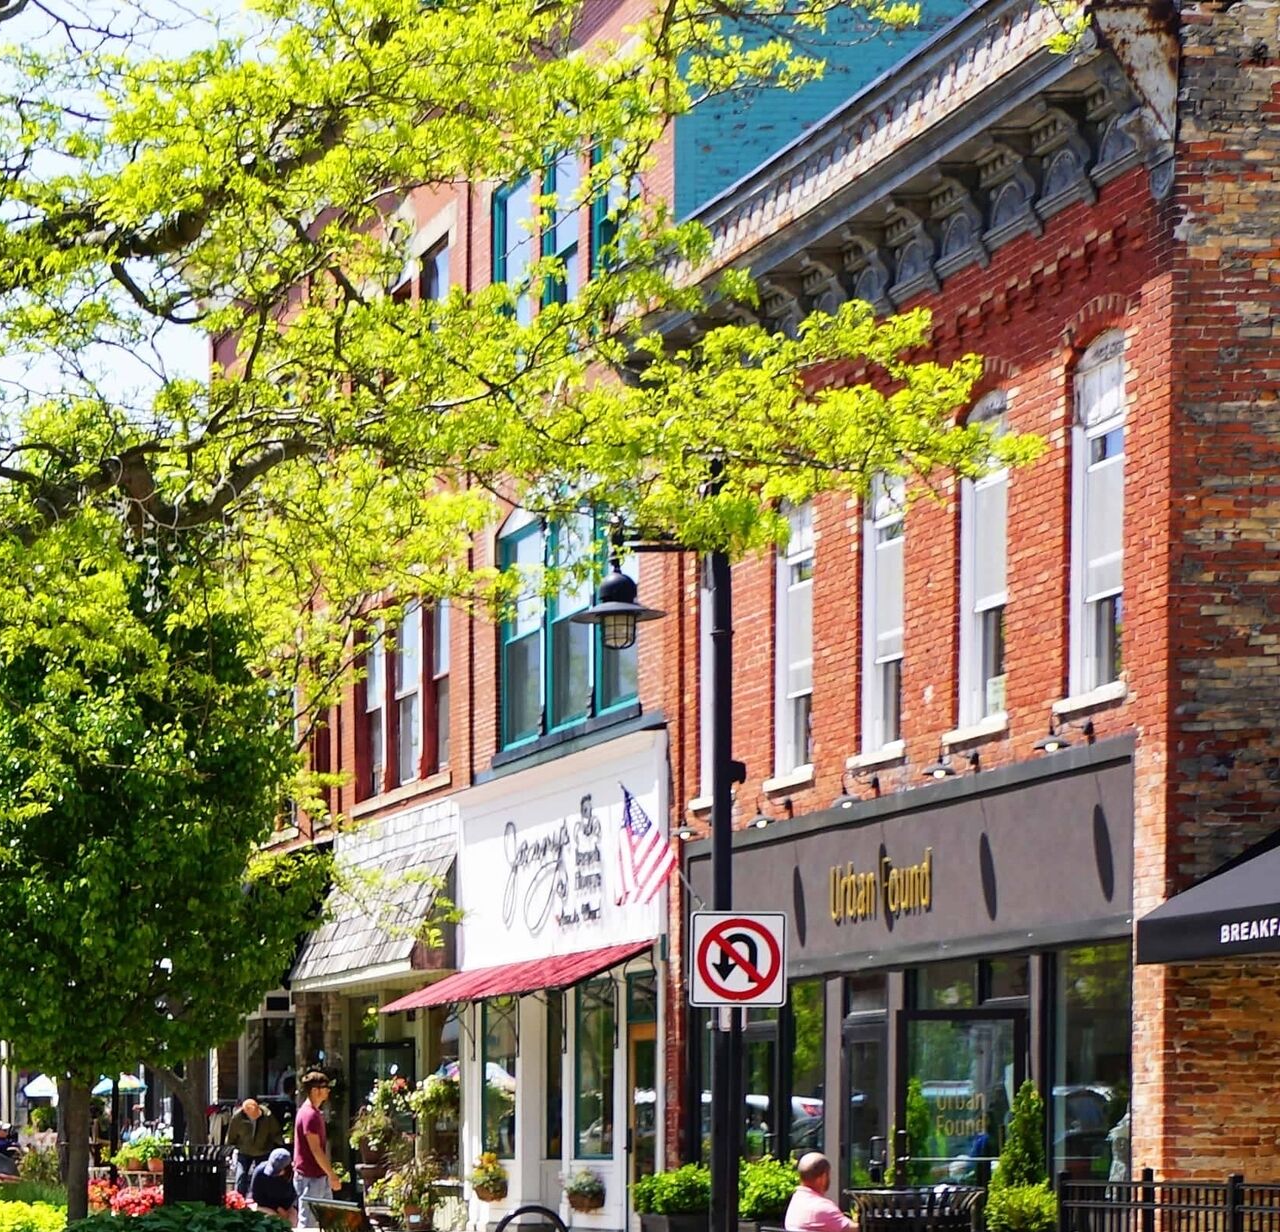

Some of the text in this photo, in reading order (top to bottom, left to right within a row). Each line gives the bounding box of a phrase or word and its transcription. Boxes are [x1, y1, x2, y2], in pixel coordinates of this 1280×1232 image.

[830, 846, 933, 920] Urban Found
[1220, 917, 1280, 944] BREAKF
[936, 1089, 985, 1111] Urban
[936, 1114, 986, 1137] Found
